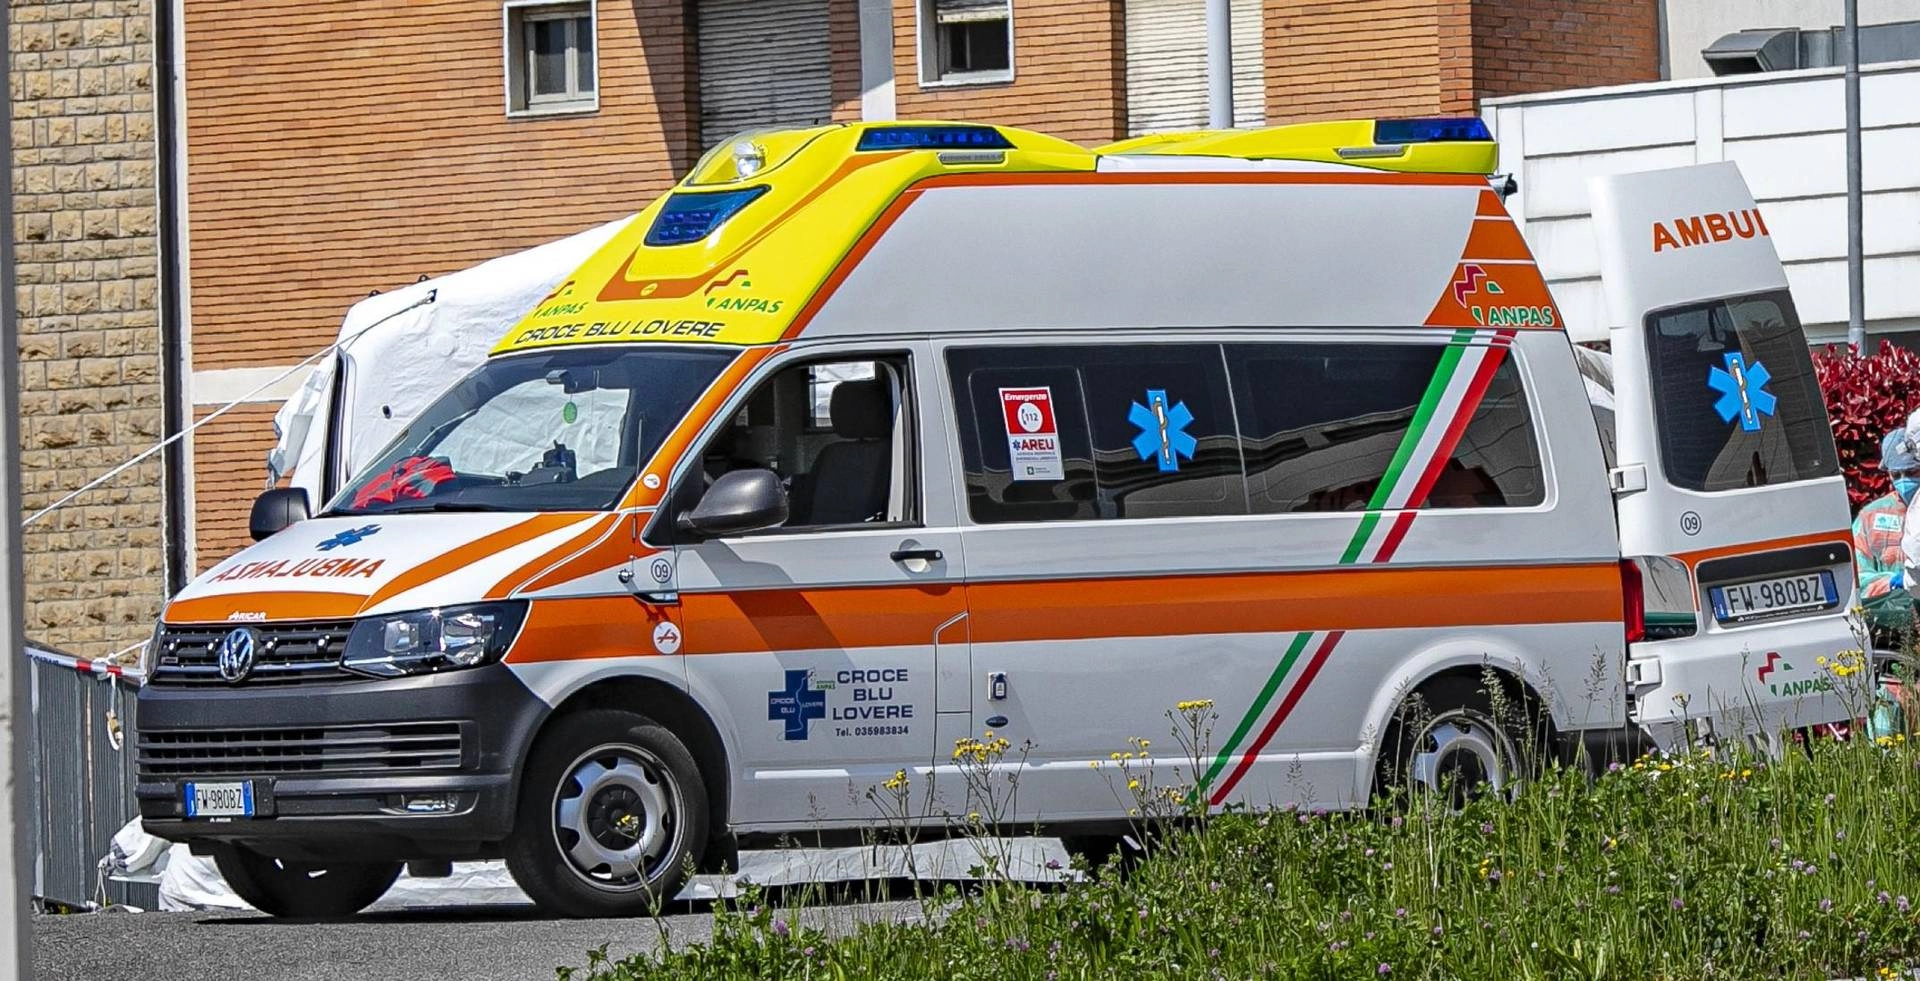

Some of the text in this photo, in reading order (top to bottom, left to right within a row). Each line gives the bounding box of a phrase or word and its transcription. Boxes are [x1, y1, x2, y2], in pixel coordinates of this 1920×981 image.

[718, 297, 783, 313] ANPAS
[1488, 306, 1554, 326] ANPAS
[514, 319, 726, 345] CROCE BLU LOVERE
[1025, 413, 1038, 421] 112
[1021, 439, 1054, 450] AREU
[1684, 517, 1698, 530] 09
[654, 564, 669, 578] 09
[1760, 577, 1825, 608] 980BZ
[837, 669, 908, 684] CROCE
[853, 687, 893, 701] BLU
[1783, 677, 1831, 696] ANPAS
[832, 705, 913, 720] LOVERE
[835, 725, 909, 737] Tel. 035983834
